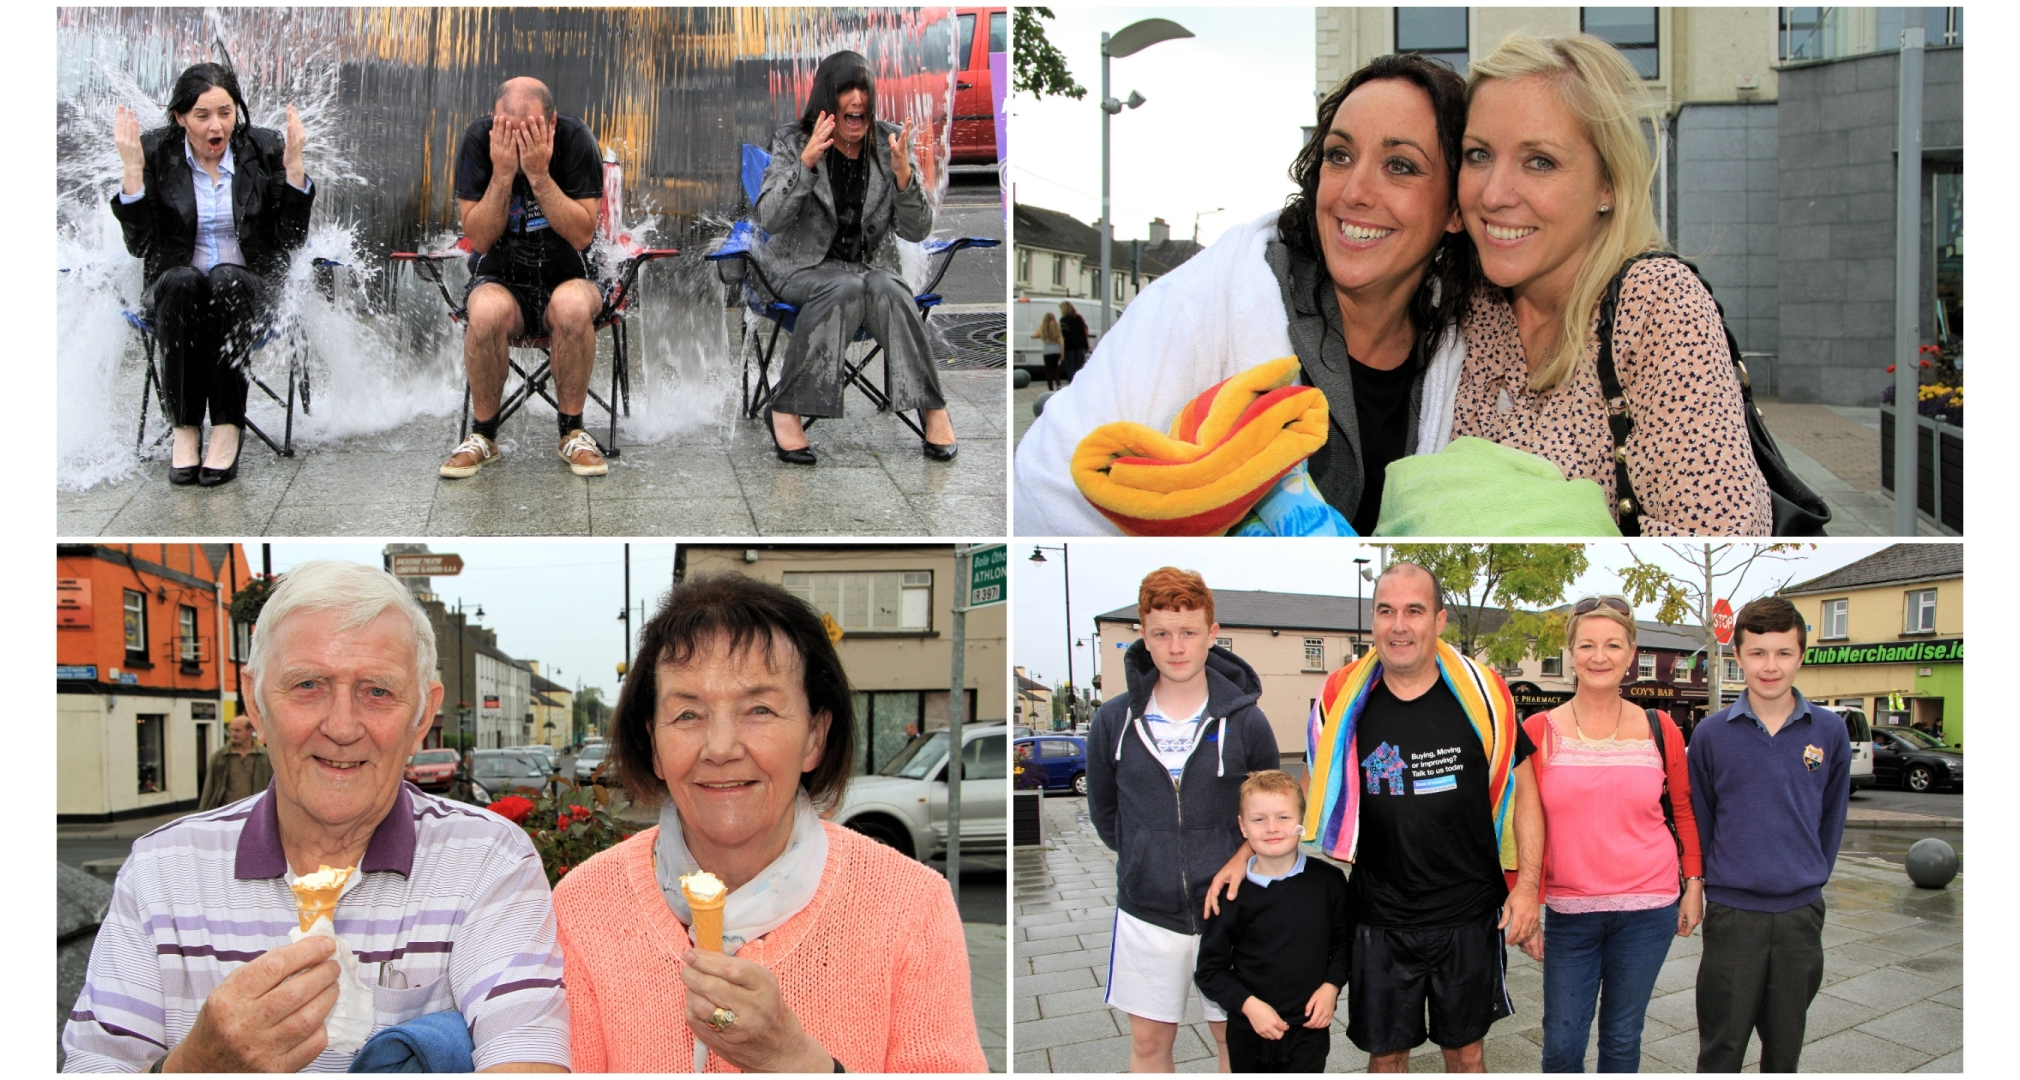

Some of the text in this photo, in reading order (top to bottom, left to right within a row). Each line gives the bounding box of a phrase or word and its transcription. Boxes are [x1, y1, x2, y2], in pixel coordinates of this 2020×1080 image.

[1714, 613, 1732, 630] STOP
[1630, 687, 1655, 696] COY'S
[1657, 688, 1674, 696] BAR
[1522, 695, 1562, 703] PHARMACY
[1411, 746, 1462, 760] Buying, Moving
[1420, 755, 1458, 768] Improving?
